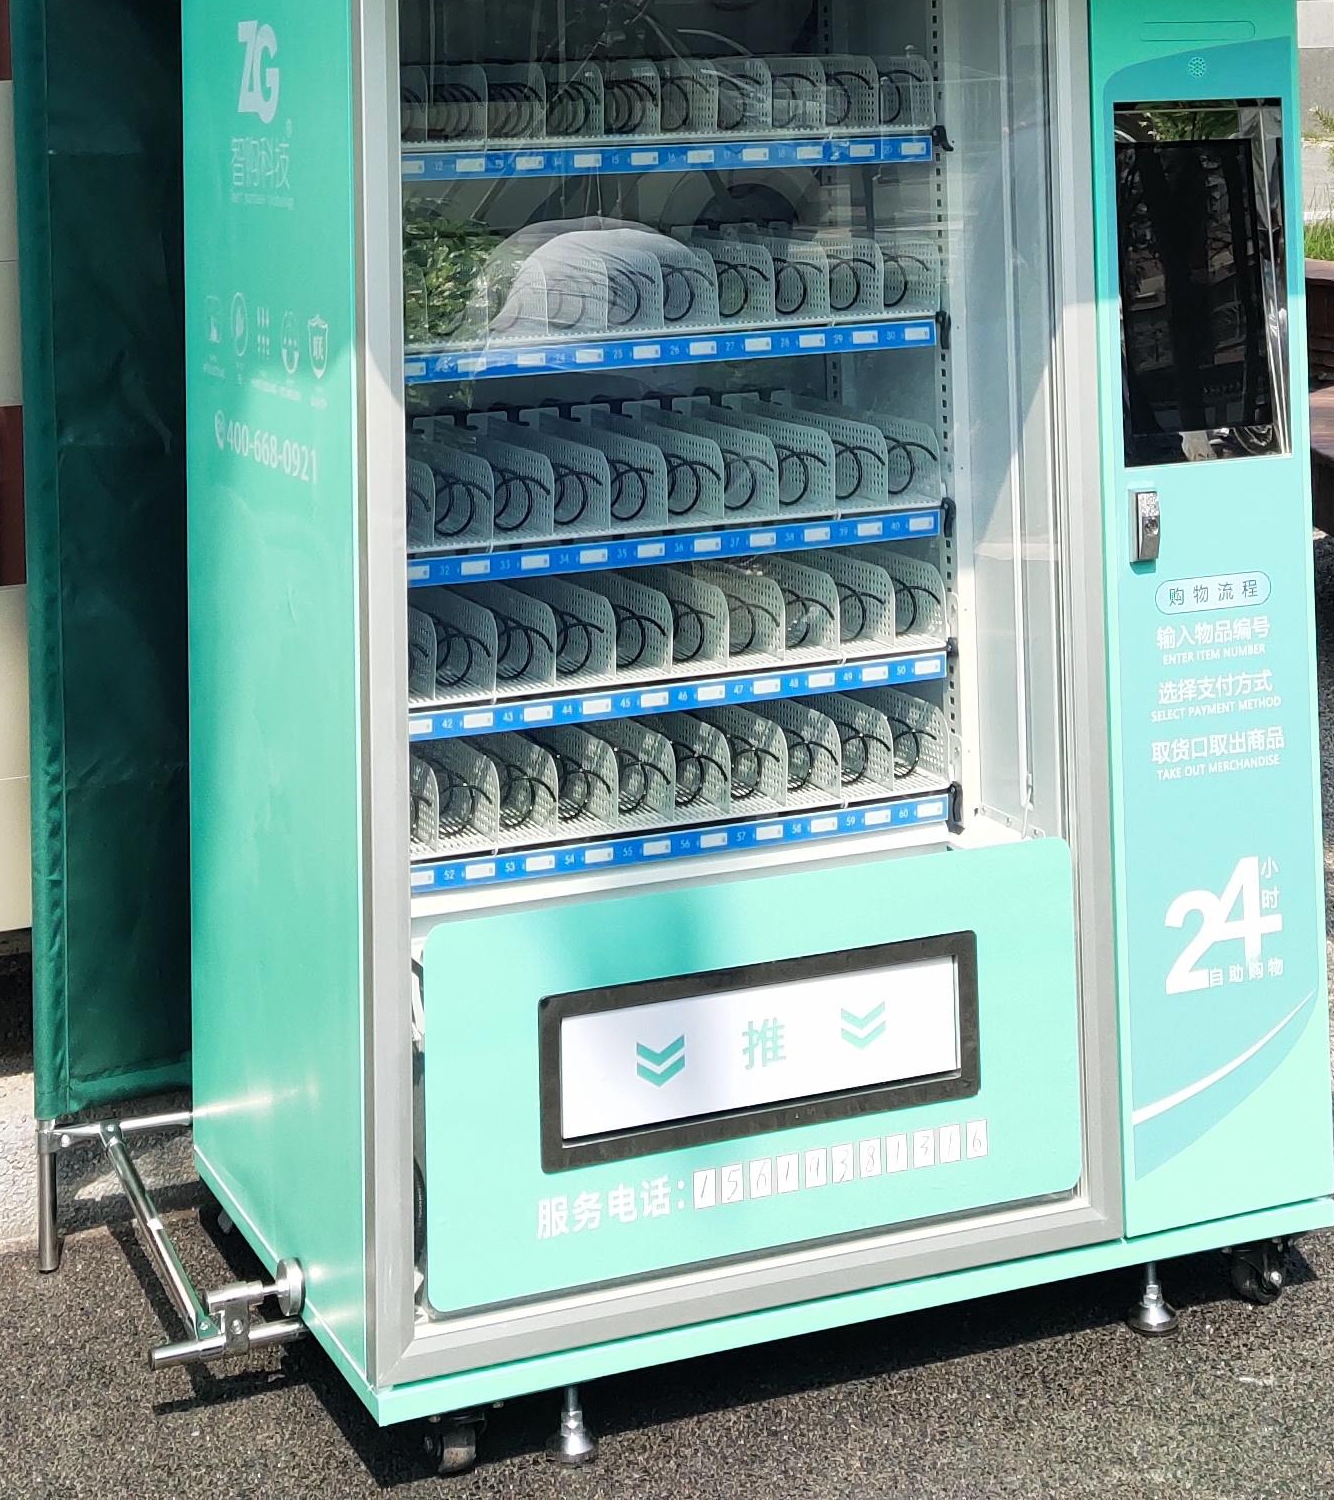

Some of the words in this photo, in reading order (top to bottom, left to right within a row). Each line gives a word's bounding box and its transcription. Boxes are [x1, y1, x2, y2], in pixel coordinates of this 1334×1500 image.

[237, 20, 280, 124] ZG
[226, 419, 317, 484] 400-668-0921
[1169, 579, 1258, 607] 购物流程
[1157, 616, 1270, 650] 输入物品编号
[1163, 652, 1194, 666] ENTER
[1197, 648, 1220, 661] ITEM
[1223, 643, 1266, 658] NUMBER
[1158, 669, 1273, 705] 选择支付方式
[1151, 708, 1185, 723] SELECT
[1188, 700, 1236, 717] PAYMENT
[1238, 696, 1282, 711] METHOD
[1151, 726, 1285, 764] 取货口取出商品
[1157, 767, 1182, 781] TAKE
[1184, 763, 1206, 777] OUT
[1208, 754, 1280, 774] MERCHANDISE
[1164, 855, 1283, 996] 24
[741, 1016, 786, 1071] 推
